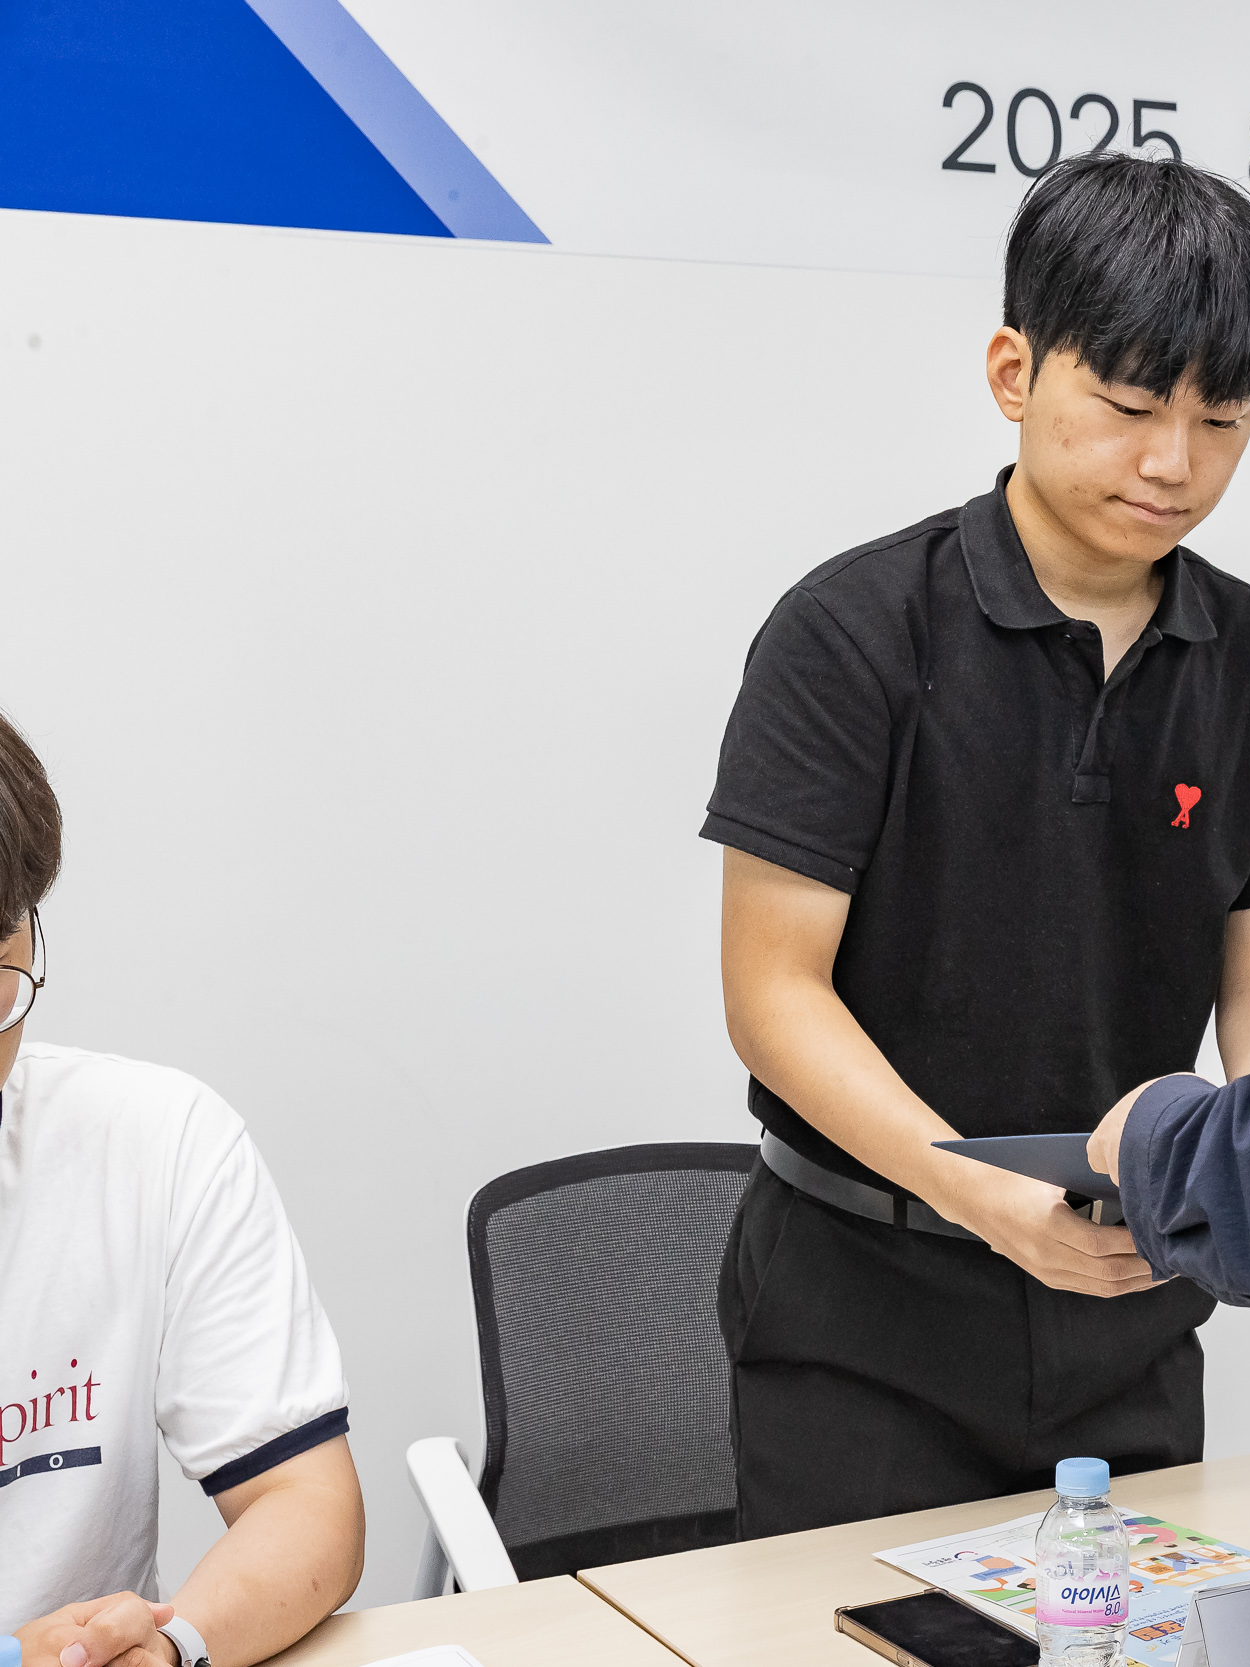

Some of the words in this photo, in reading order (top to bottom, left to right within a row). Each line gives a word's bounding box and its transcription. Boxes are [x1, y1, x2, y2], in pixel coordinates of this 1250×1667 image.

[942, 81, 1181, 178] 2025
[1061, 1584, 1120, 1605] 아이시스
[1104, 1602, 1120, 1616] 8.0
